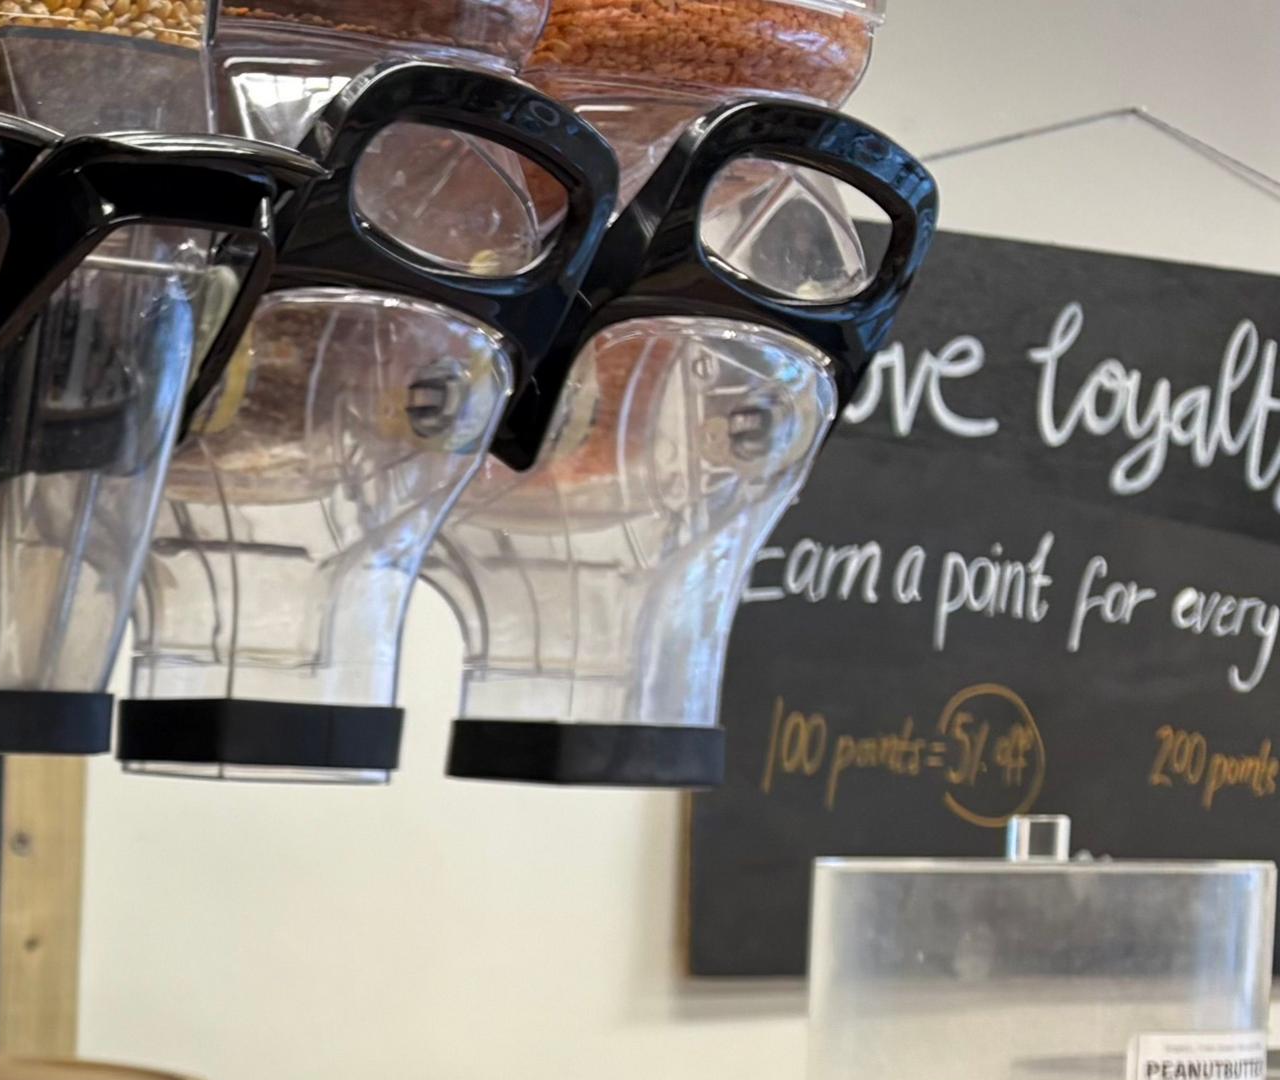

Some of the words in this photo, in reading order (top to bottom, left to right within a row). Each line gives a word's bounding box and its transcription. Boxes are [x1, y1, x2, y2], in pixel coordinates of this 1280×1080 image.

[893, 545, 926, 604] a
[933, 531, 1054, 651] point
[1067, 555, 1157, 652] for
[1171, 587, 1280, 692] every
[760, 695, 828, 795] 100
[1149, 724, 1207, 786] 200
